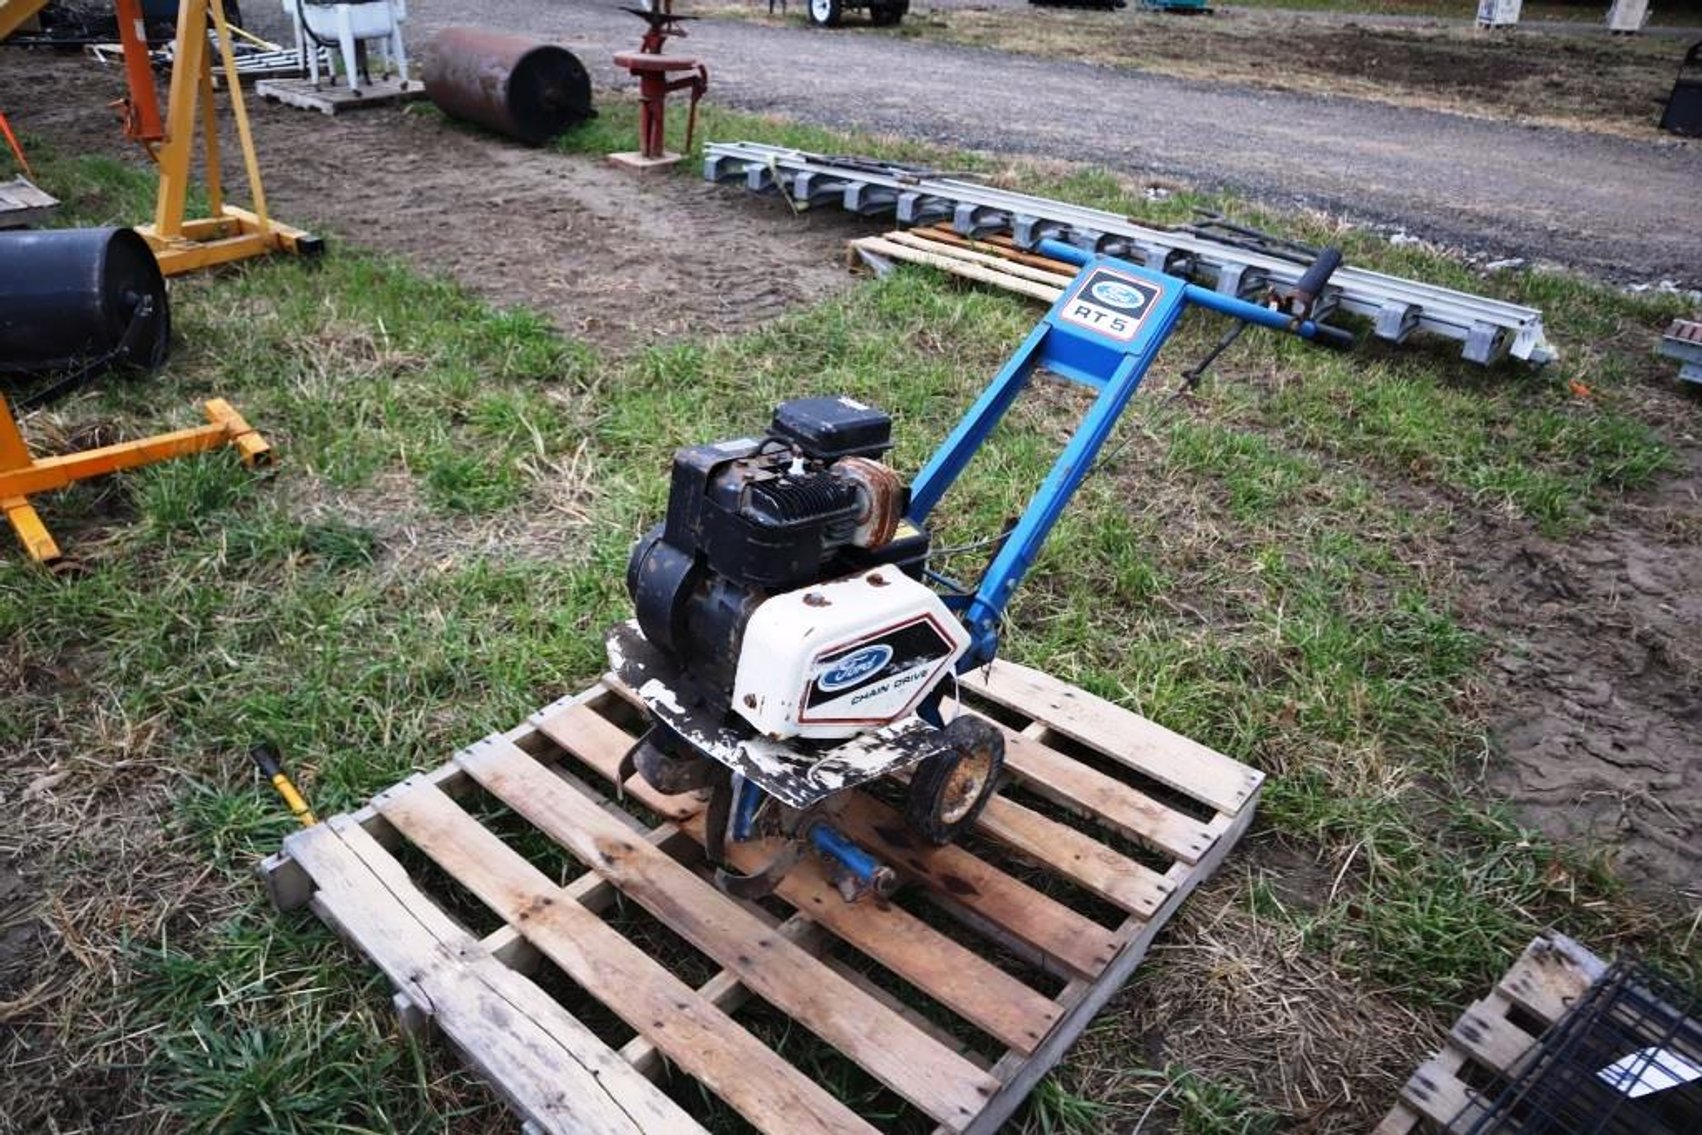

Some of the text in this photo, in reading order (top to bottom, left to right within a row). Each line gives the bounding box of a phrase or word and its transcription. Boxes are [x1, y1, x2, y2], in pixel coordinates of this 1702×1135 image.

[834, 653, 877, 681] Ford
[851, 669, 928, 706] CHAIN DRIVE
